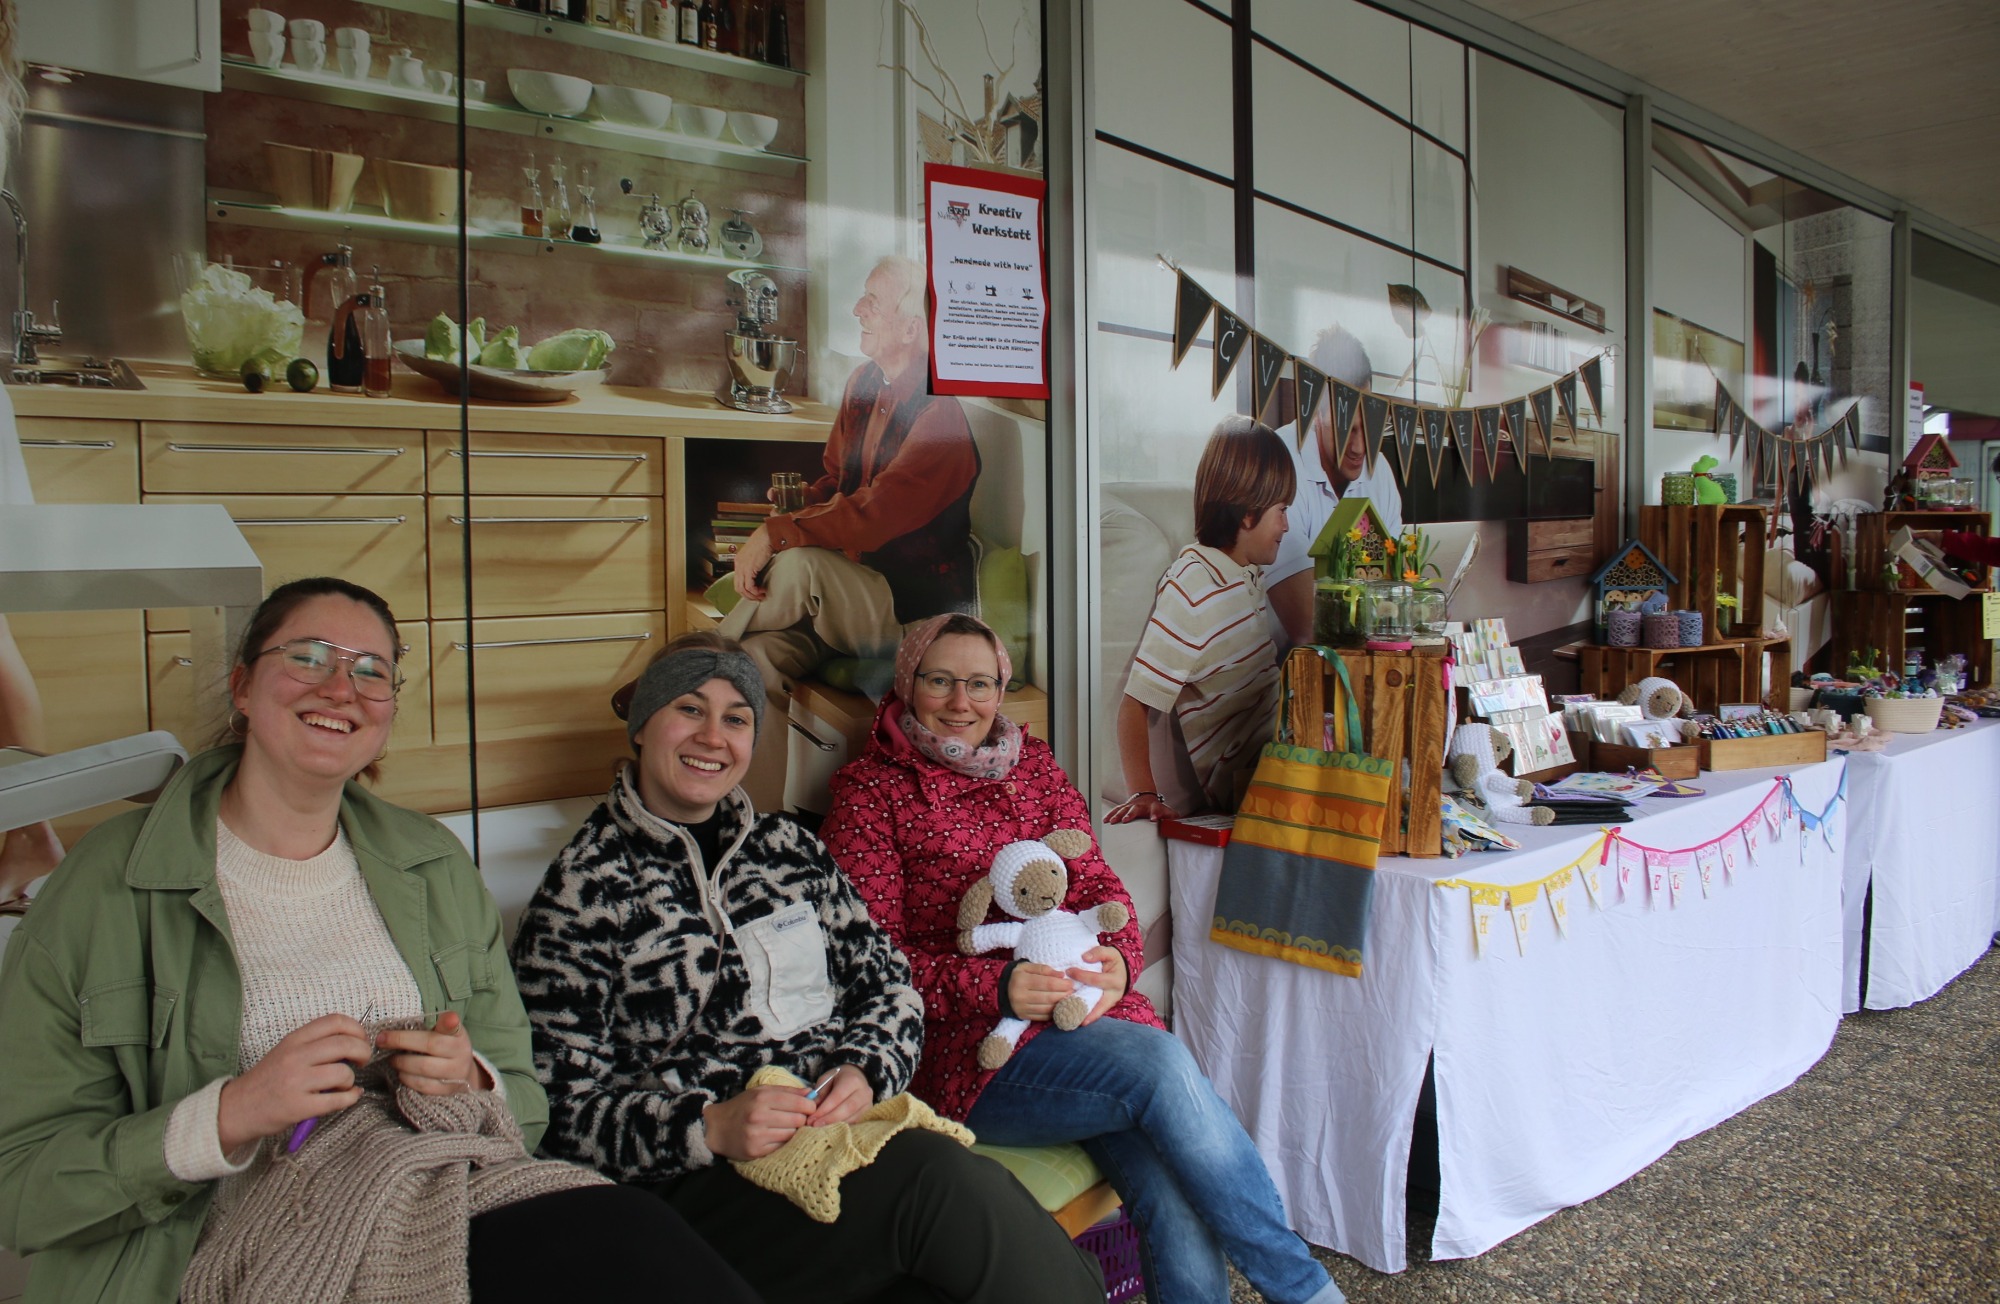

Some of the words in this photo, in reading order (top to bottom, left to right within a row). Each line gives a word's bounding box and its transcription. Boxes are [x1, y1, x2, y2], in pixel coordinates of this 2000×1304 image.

[978, 203, 1023, 220] Kreativ
[972, 222, 1032, 241] Werkstatt
[993, 260, 1012, 270] with
[1219, 330, 1348, 431] CVJM
[1399, 389, 1573, 450] KREATIV
[1479, 871, 1600, 934] HOME
[1621, 812, 1780, 891] WELCOME
